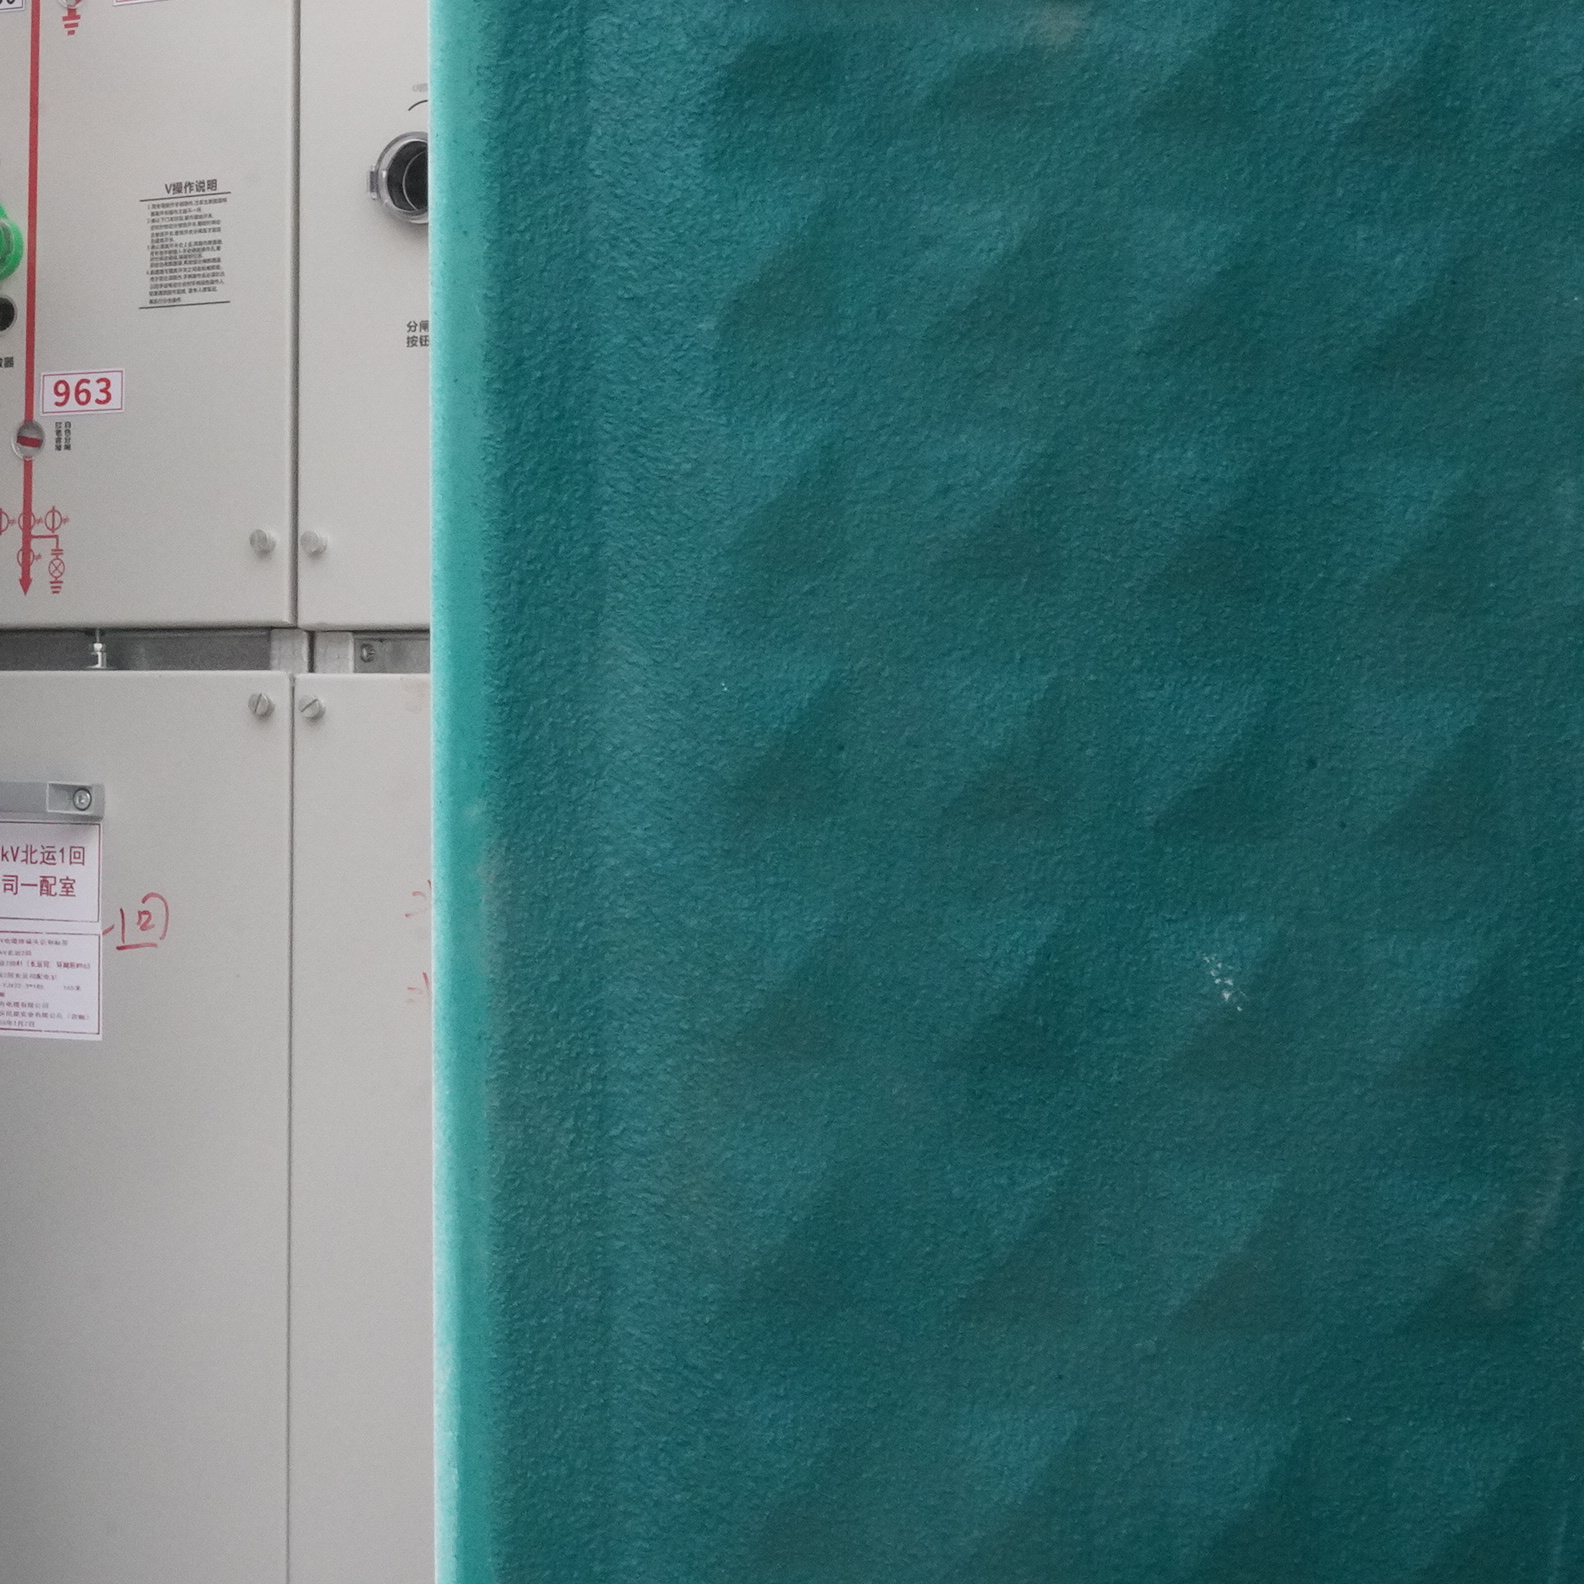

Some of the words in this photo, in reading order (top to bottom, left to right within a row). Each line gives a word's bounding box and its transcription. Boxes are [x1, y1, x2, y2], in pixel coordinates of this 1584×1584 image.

[164, 179, 218, 195] V操作说明
[53, 377, 112, 407] 963
